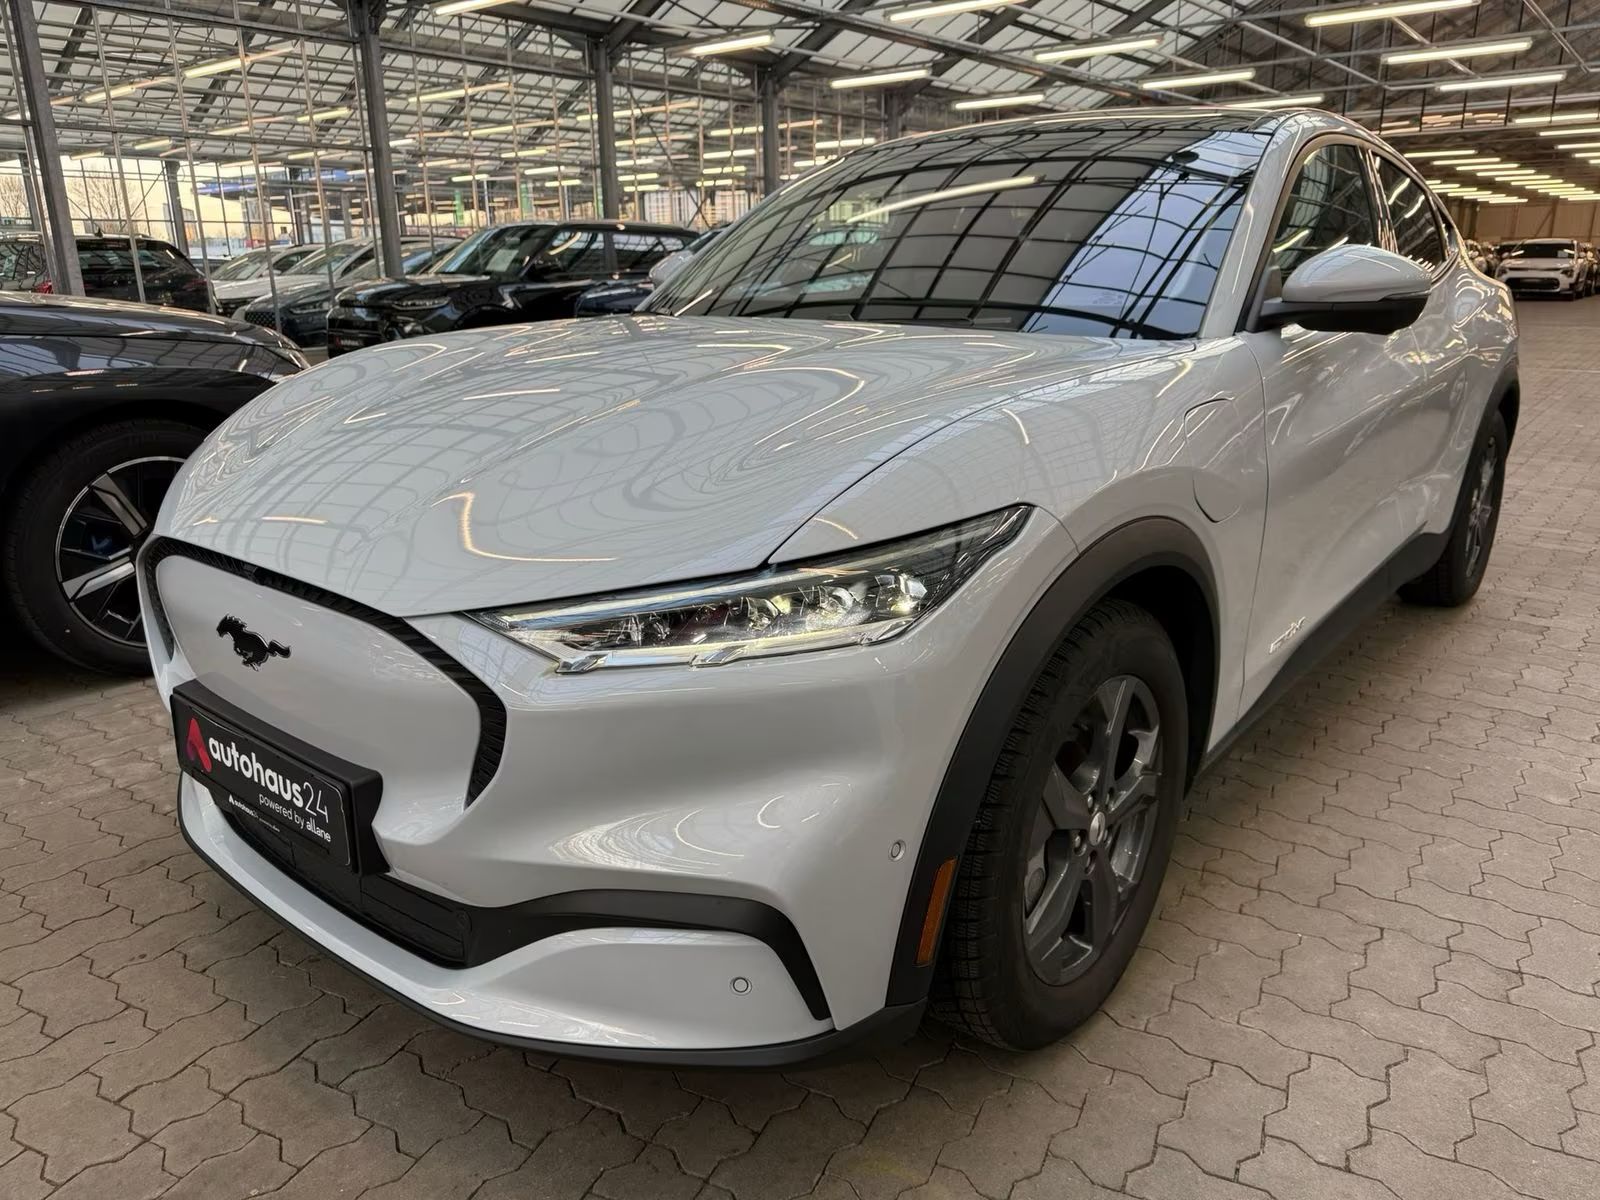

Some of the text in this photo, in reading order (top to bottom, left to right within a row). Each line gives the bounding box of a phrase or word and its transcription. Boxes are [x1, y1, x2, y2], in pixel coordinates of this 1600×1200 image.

[208, 737, 329, 823] autohaus24
[258, 793, 293, 819] powered
[294, 811, 305, 829] by
[306, 818, 332, 842] allane
